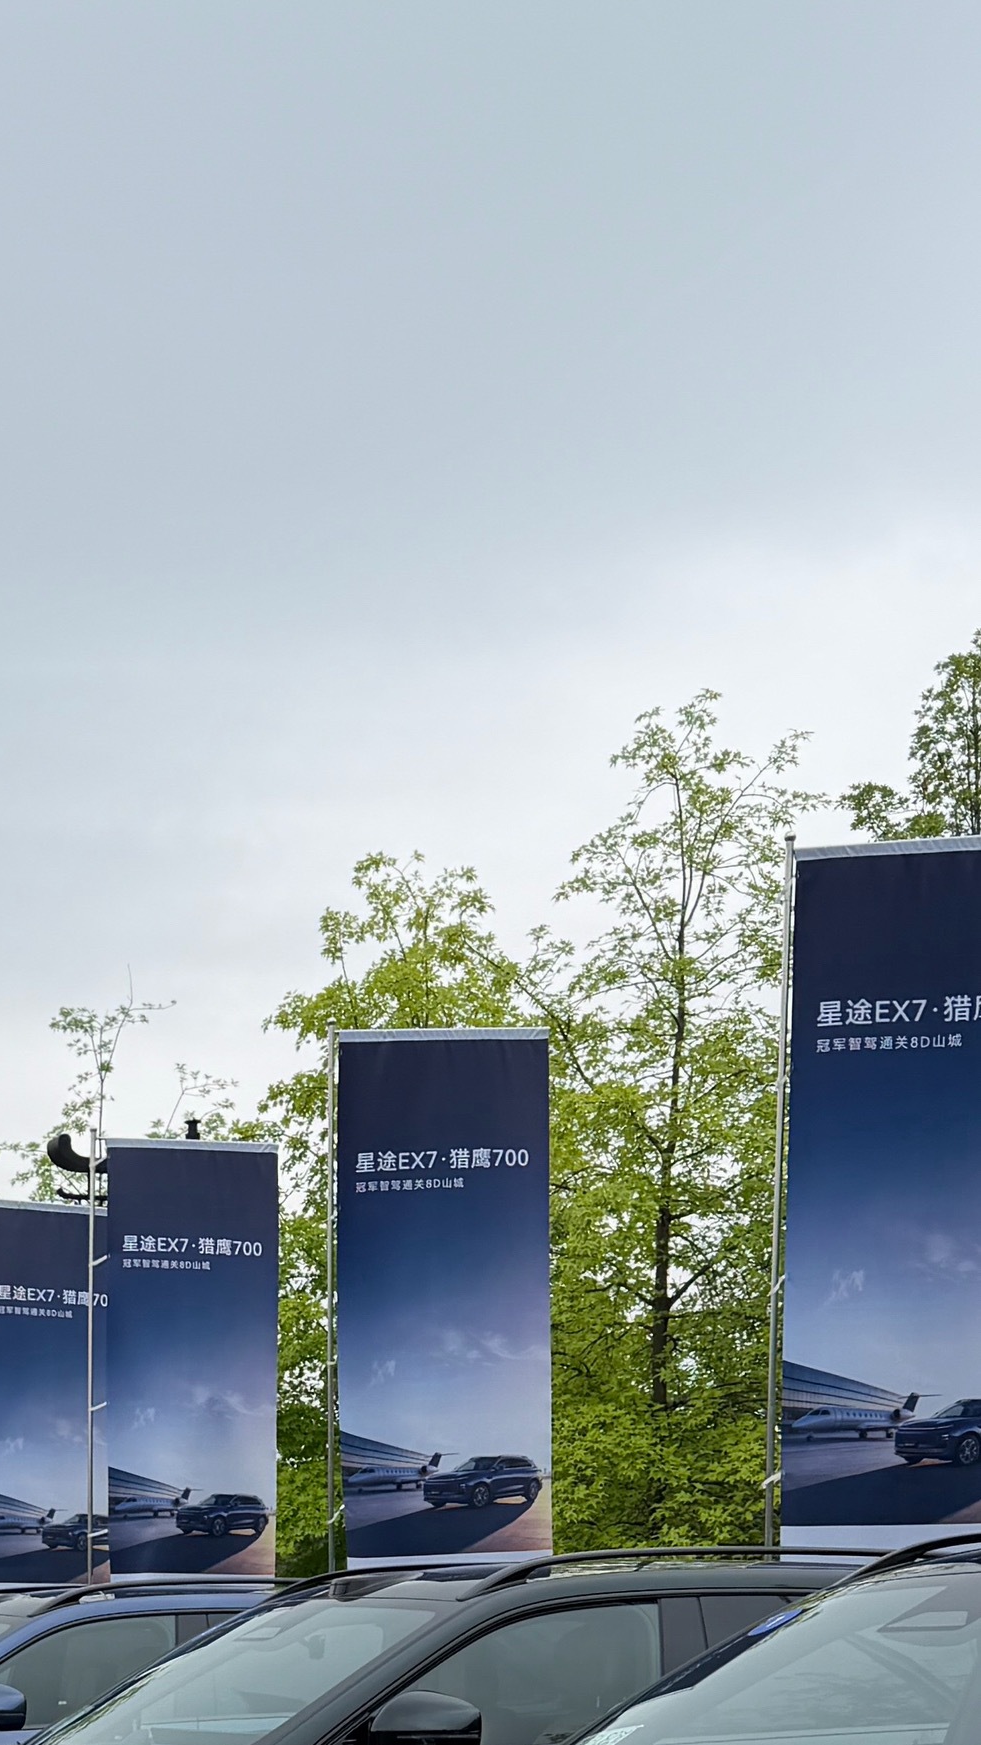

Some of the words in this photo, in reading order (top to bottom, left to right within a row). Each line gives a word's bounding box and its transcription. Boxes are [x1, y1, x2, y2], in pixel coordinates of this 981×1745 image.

[816, 994, 981, 1027] 星途EX7·猎
[816, 1033, 963, 1053] 冠军智驾通关8D山城
[355, 1147, 530, 1173] 星途EX7·猎鹰700
[122, 1235, 263, 1256] 星途EX7·猎鹰700
